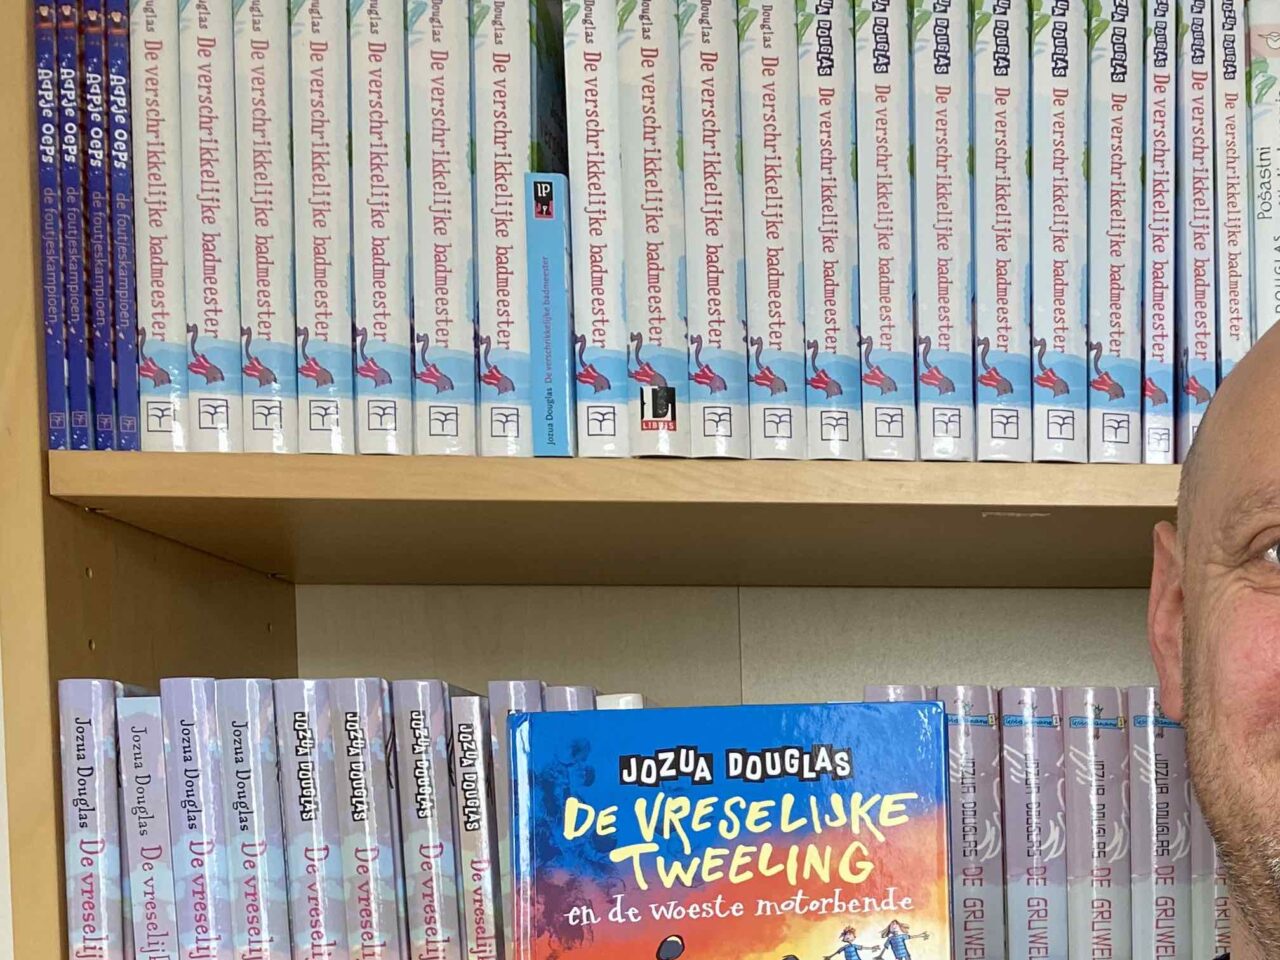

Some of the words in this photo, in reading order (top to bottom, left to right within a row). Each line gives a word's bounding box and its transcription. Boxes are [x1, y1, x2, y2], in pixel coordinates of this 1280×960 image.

[197, 36, 216, 58] De
[197, 64, 221, 225] verschrikkelijke
[1257, 146, 1273, 221] Pošastni
[202, 232, 223, 338] badmeester
[75, 717, 92, 761] Jozua
[458, 723, 476, 767] JOZUA
[621, 748, 713, 784] JOZUA
[729, 748, 851, 780] DOUGLAS
[72, 766, 95, 828] Douglas
[461, 770, 479, 832] DOUGLAS
[563, 797, 619, 840] DE
[634, 792, 918, 854] VRESELIJKE
[79, 839, 106, 868] De
[469, 859, 491, 881] De
[609, 841, 875, 890] TWEELING
[564, 905, 600, 926] en
[608, 895, 642, 923] de
[650, 895, 744, 920] woeste
[755, 888, 914, 916] motorbende
